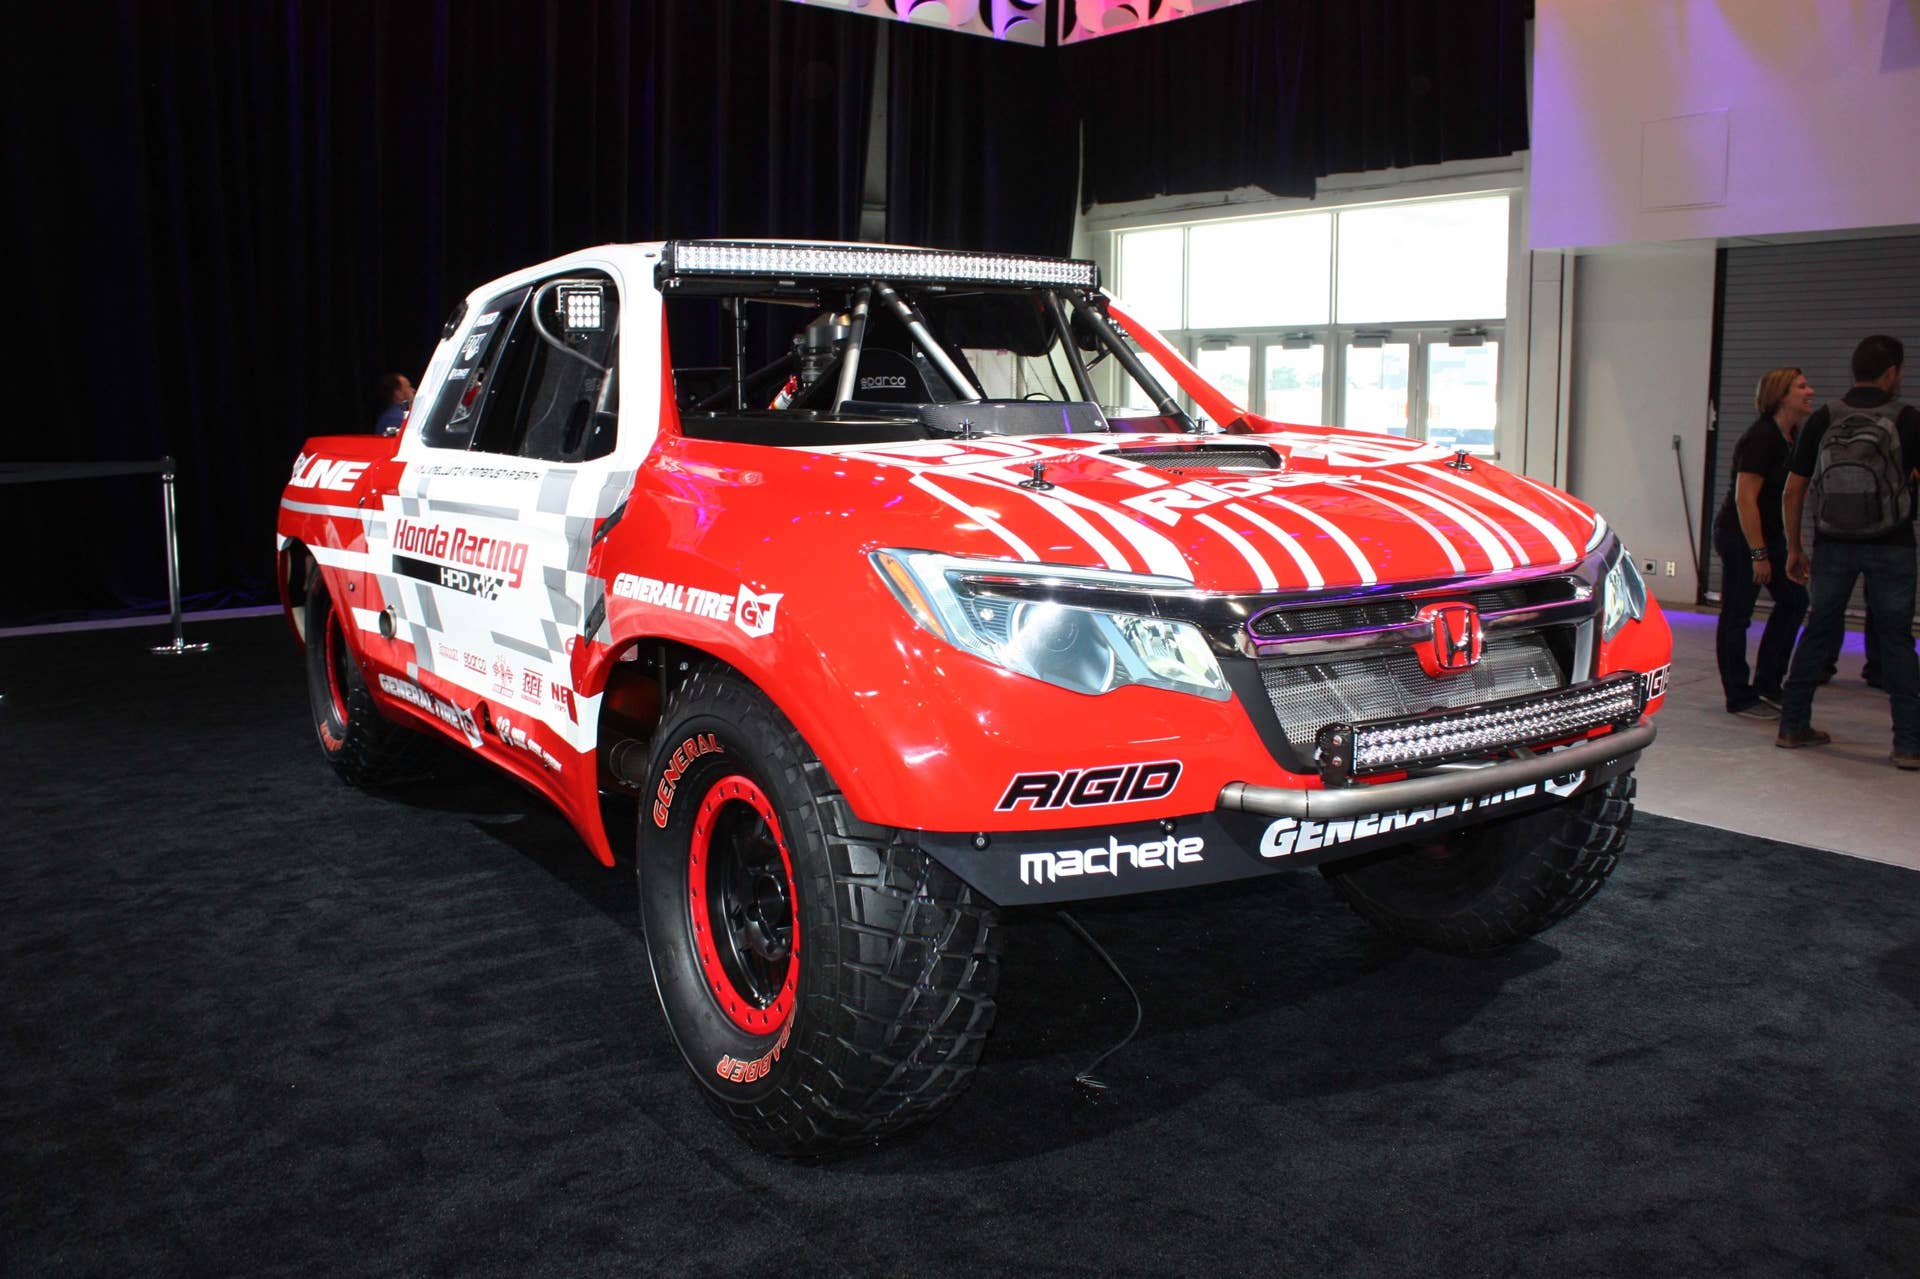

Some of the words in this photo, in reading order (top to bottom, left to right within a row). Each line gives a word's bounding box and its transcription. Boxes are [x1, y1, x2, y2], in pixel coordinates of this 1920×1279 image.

[861, 376, 906, 389] sparco
[392, 518, 449, 559] Honda
[450, 527, 529, 589] Racing
[440, 567, 470, 592] HPD
[613, 572, 684, 610] GENERAL
[685, 588, 736, 622] TIRE
[653, 733, 726, 829] GENERAL
[994, 759, 1183, 812] RIGID
[1020, 835, 1204, 885] machete
